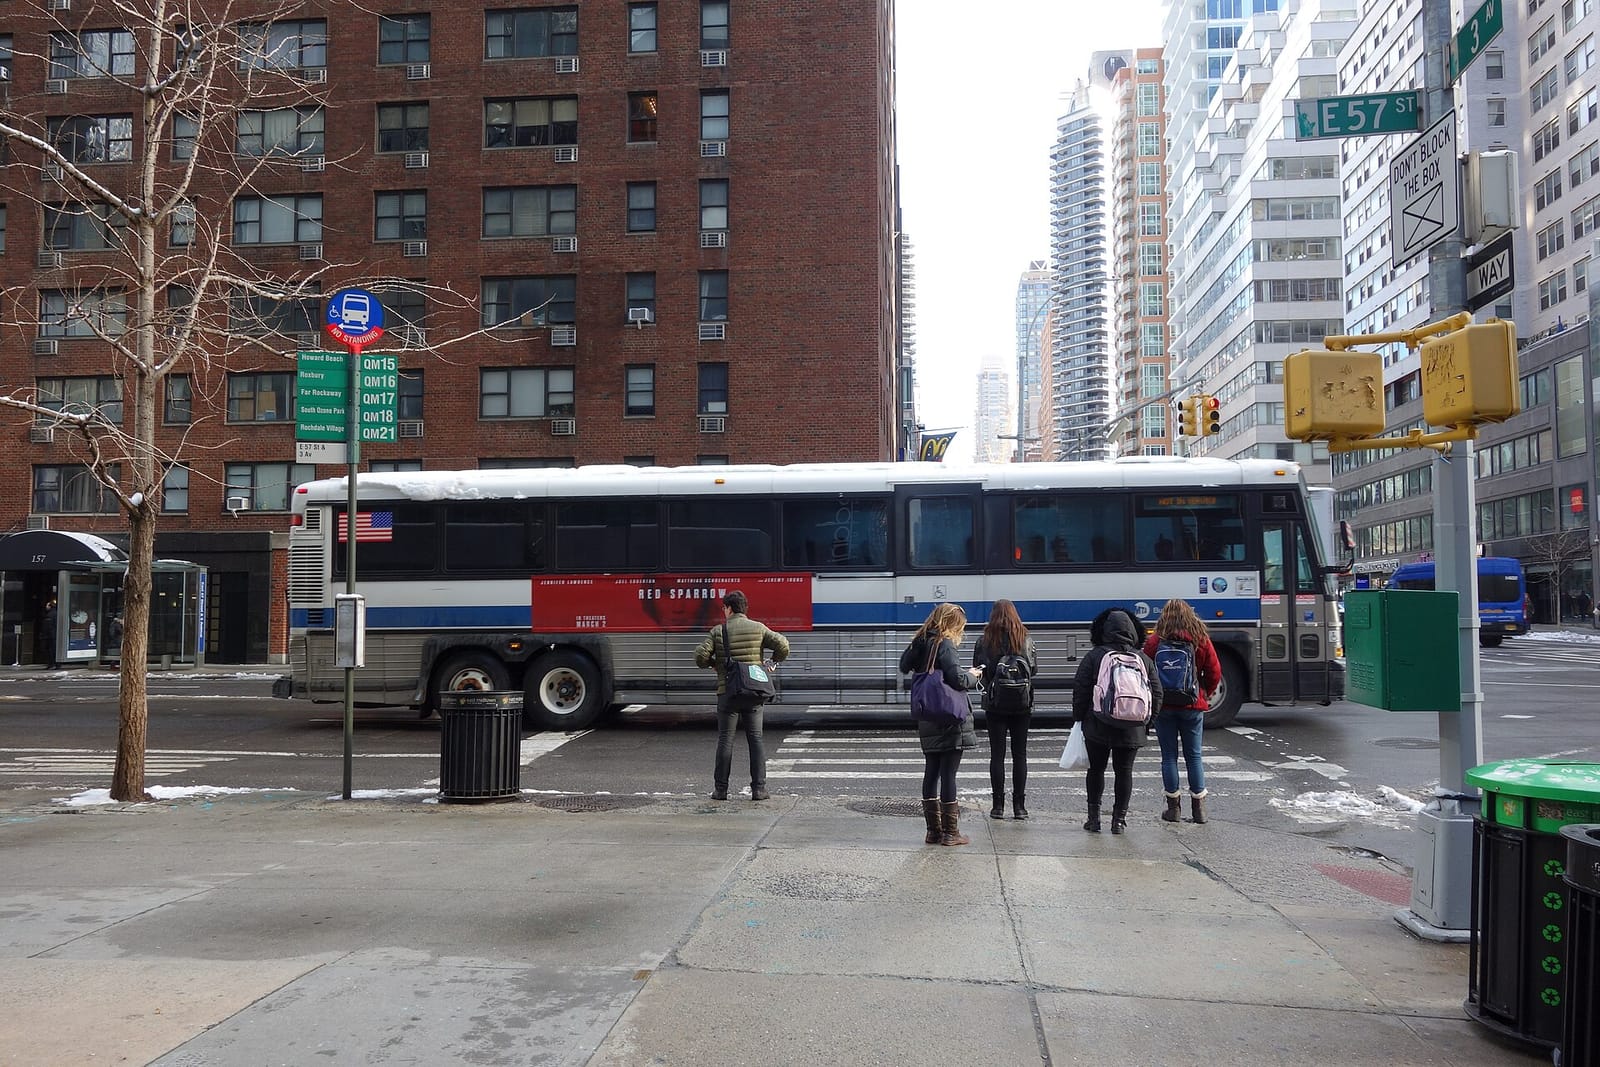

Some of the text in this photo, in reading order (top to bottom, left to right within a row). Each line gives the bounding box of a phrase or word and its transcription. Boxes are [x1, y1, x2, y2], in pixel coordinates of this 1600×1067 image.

[1470, 0, 1496, 54] 3 AV
[1322, 96, 1415, 134] E 57 ST
[1393, 122, 1451, 185] DON'T BLOCK
[1403, 160, 1441, 201] THE BOX
[1478, 253, 1506, 290] WAY
[330, 327, 379, 345] NO STANDING
[301, 354, 326, 362] Howard
[363, 358, 396, 371] QM15
[300, 372, 324, 380] Roxbury
[364, 375, 396, 388] QM16
[311, 390, 342, 398] Rockaway
[363, 392, 395, 405] QM17
[363, 410, 393, 423] QM18
[326, 424, 345, 432] Village
[363, 427, 395, 440] QM21
[31, 554, 46, 563] 157
[638, 588, 727, 599] RED SPARROW
[576, 620, 599, 628] MARCH
